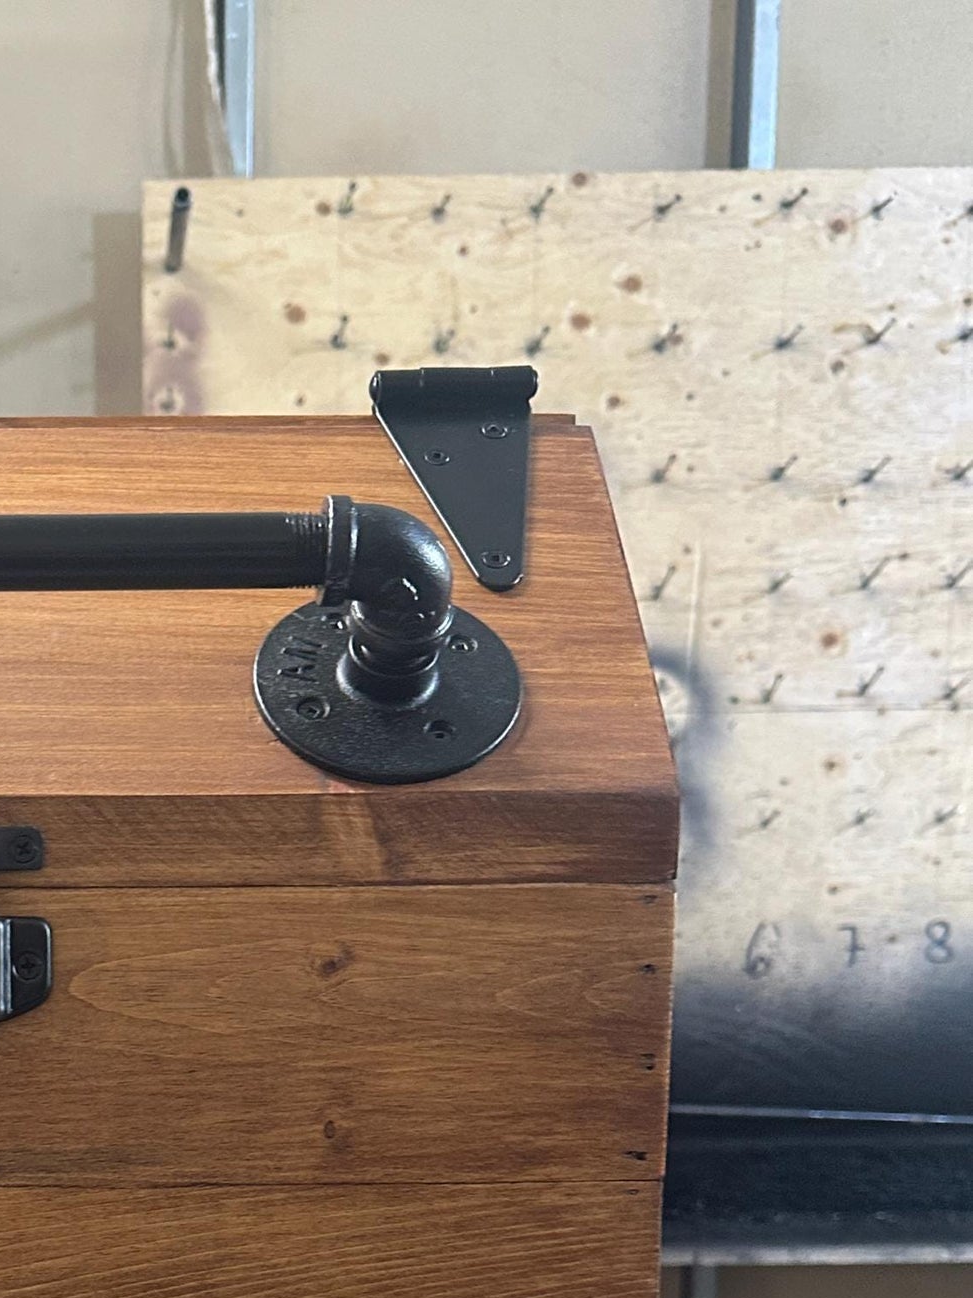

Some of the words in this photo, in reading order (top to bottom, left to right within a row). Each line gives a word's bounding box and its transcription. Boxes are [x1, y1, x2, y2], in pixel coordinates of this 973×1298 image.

[743, 920, 780, 980] 6
[838, 922, 866, 968] 7
[925, 919, 955, 964] 8
